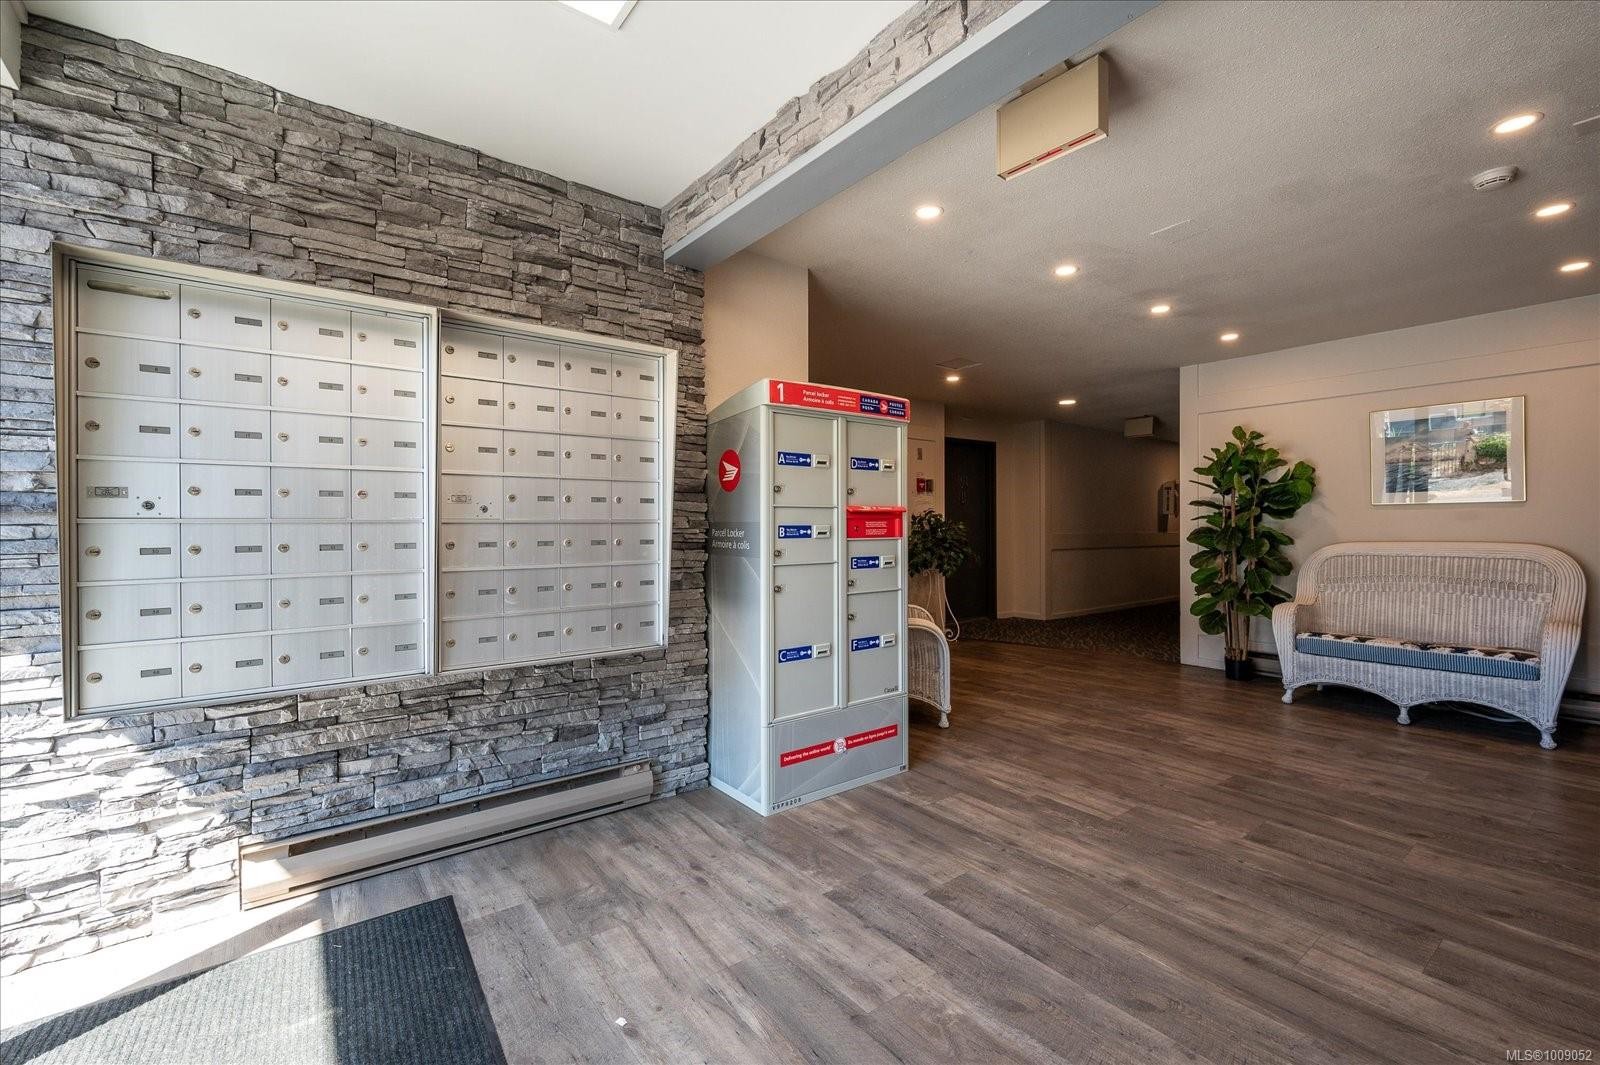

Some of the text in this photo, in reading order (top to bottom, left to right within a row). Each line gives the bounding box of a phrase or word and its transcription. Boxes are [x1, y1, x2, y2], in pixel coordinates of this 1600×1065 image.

[777, 383, 784, 402] 1
[778, 453, 786, 464] A
[851, 459, 858, 469] D
[712, 528, 744, 538] Parcel Locker
[779, 527, 786, 537] B
[712, 540, 732, 549] Armoire
[738, 541, 750, 550] colis
[852, 558, 857, 568] E
[852, 640, 857, 651] F
[779, 649, 786, 662] C
[783, 753, 802, 762] Delivering
